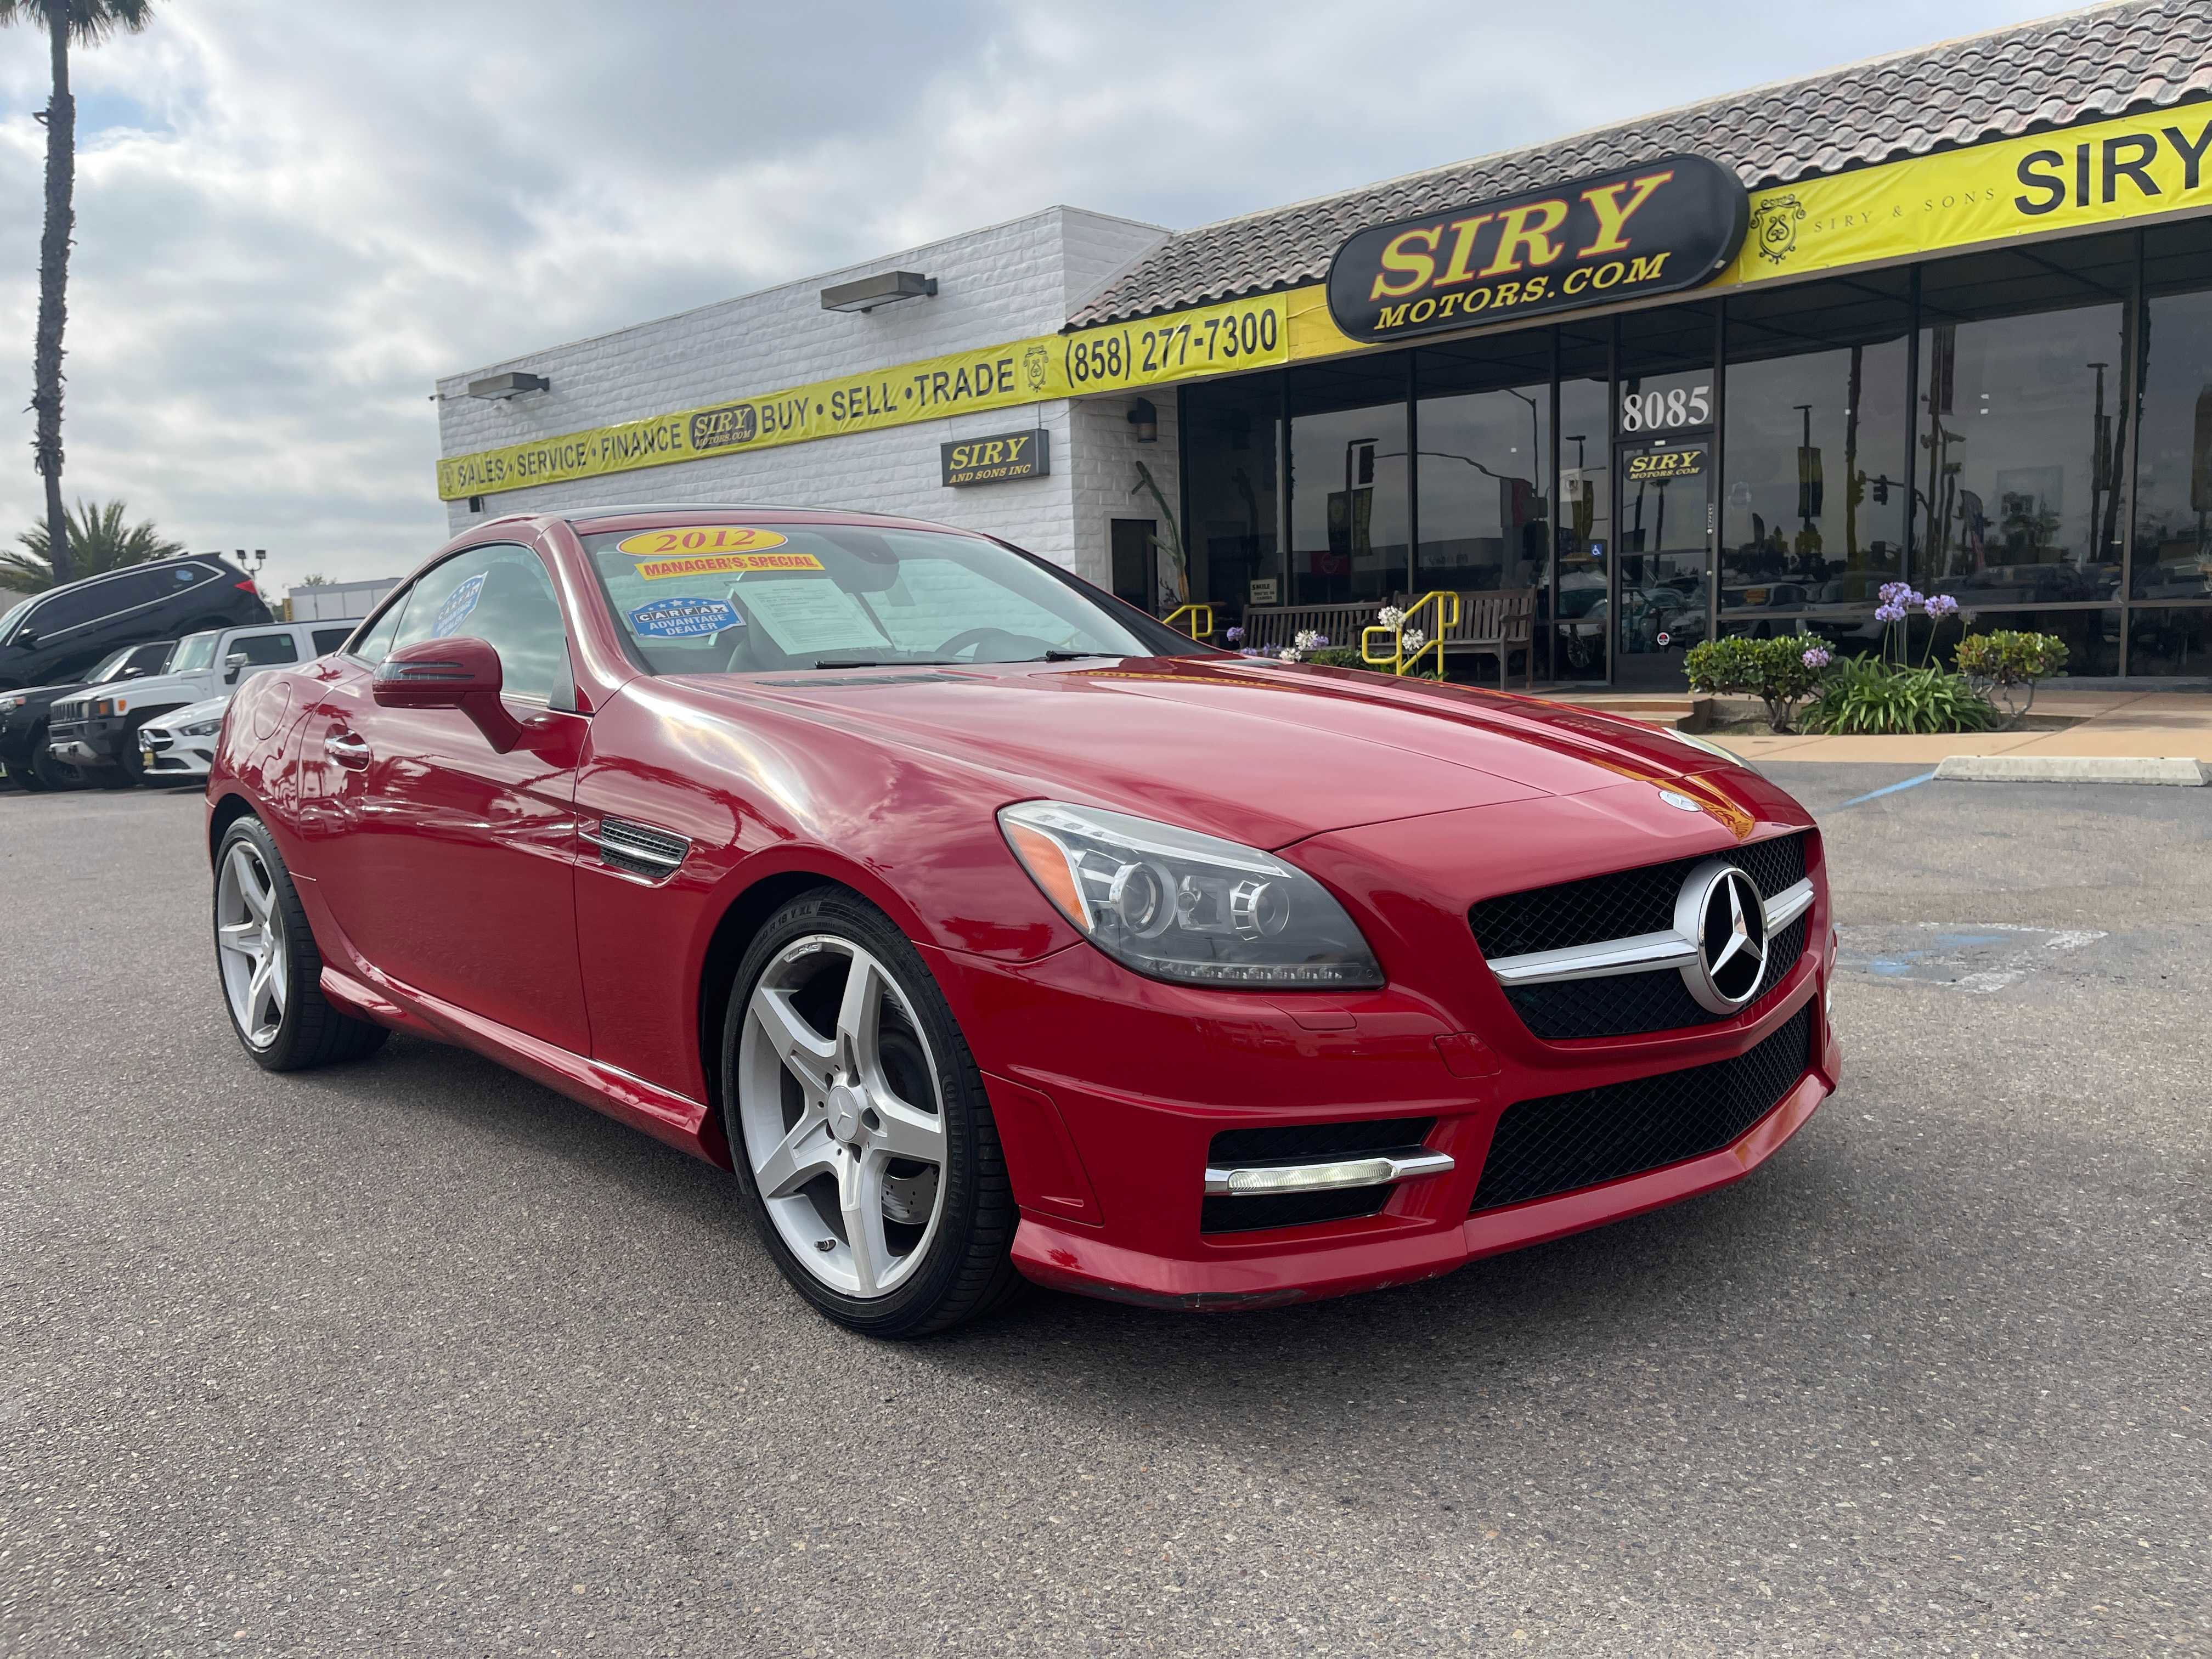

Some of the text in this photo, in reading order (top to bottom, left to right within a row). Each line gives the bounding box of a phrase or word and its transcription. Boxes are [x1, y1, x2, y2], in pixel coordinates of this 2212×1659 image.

[2013, 120, 2212, 216] SIRY
[1813, 187, 1996, 234] SIRY & SONS
[1368, 170, 1674, 302] SIRY
[1373, 251, 1671, 330] MOTORS.COM
[1065, 308, 1277, 388] (858) 277-7300
[761, 358, 1014, 434] BUY SELL TRADE
[1623, 386, 1709, 432] 8085
[695, 407, 752, 437] SIRY
[695, 430, 752, 448] MOTORS.COM
[949, 436, 1029, 470] SIRY
[457, 423, 682, 488] SALES SERVICE FINANCE
[1629, 450, 1701, 472] SIRY
[949, 464, 1031, 483] AND SONS INC
[1629, 467, 1700, 480] MOTORS.COM
[653, 529, 756, 553] 2012
[644, 556, 816, 577] MANAGER'S SPECIAL
[639, 606, 725, 622] CARFAX
[649, 614, 727, 630] ADVANTAGE
[665, 623, 719, 636] DEALER
